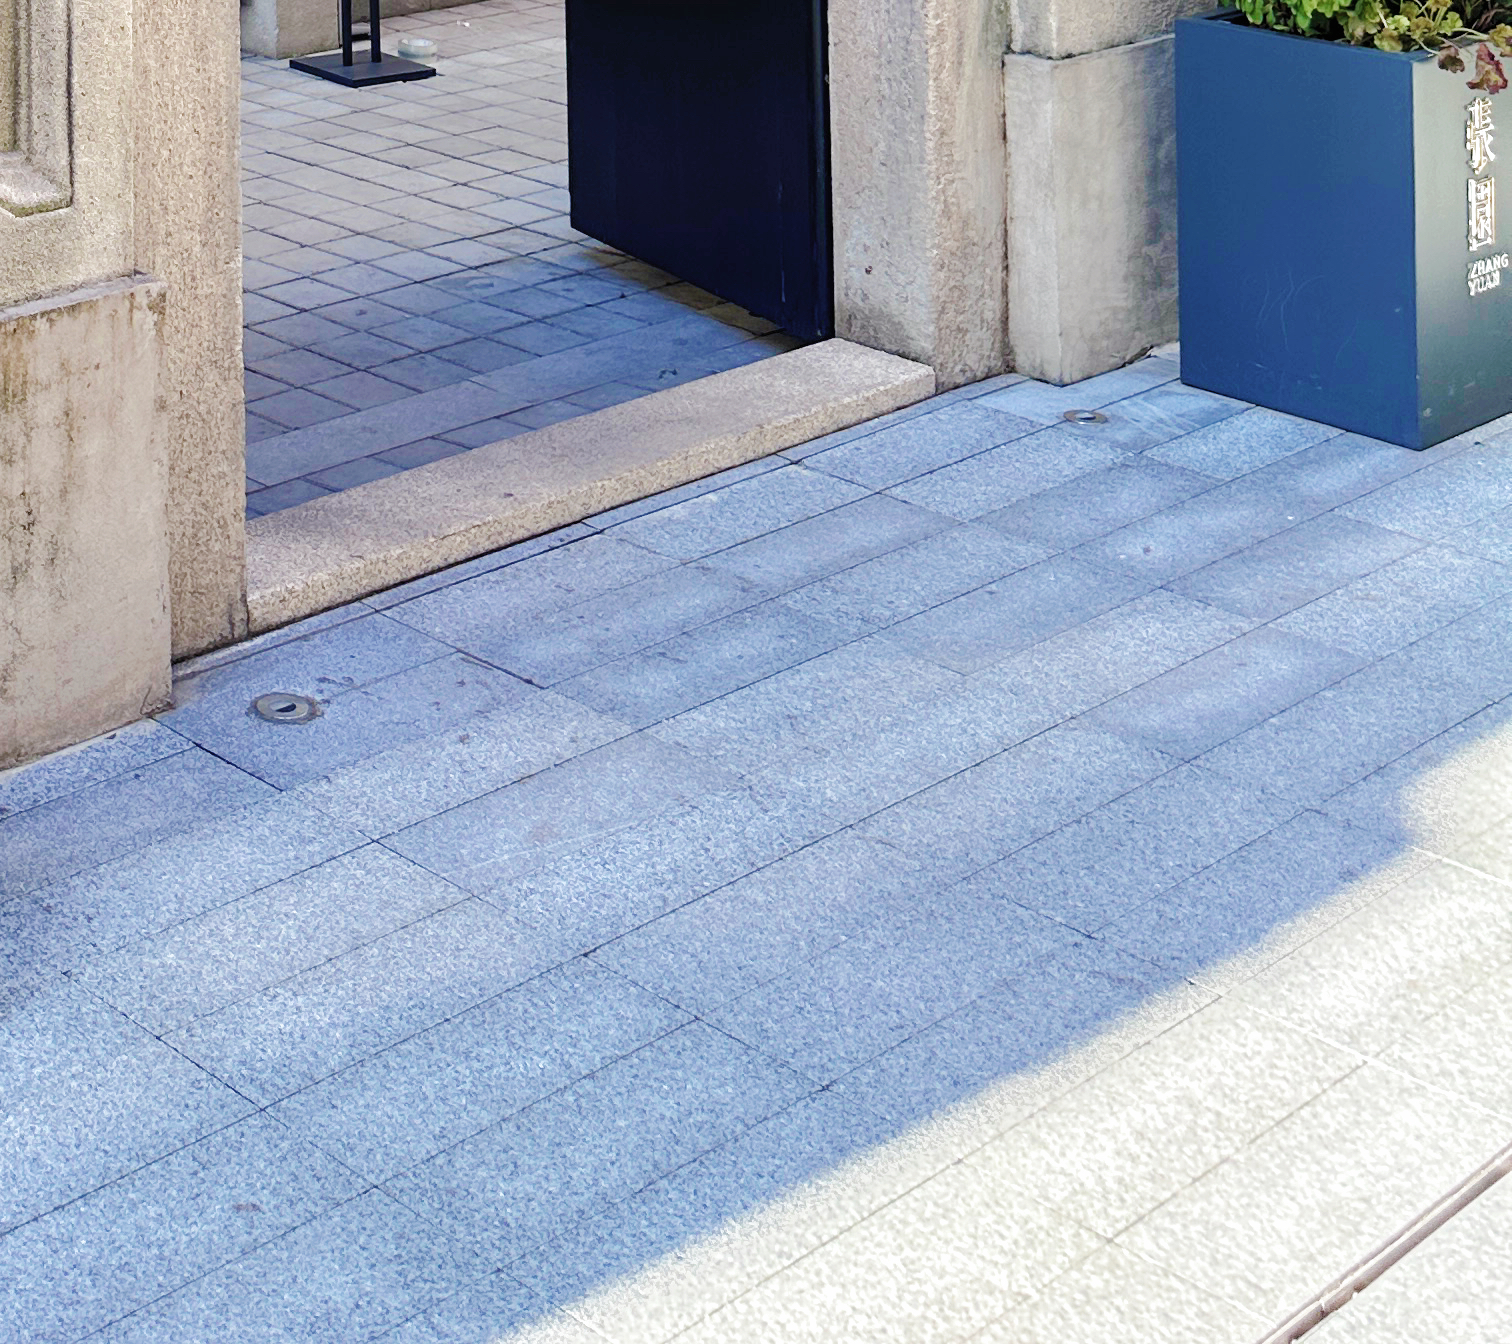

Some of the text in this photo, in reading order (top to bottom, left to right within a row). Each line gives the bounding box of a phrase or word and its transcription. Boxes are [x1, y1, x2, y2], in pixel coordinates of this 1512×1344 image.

[1465, 97, 1496, 252] 張園
[1468, 253, 1509, 280] ZHANG
[1468, 270, 1501, 297] YUAN
